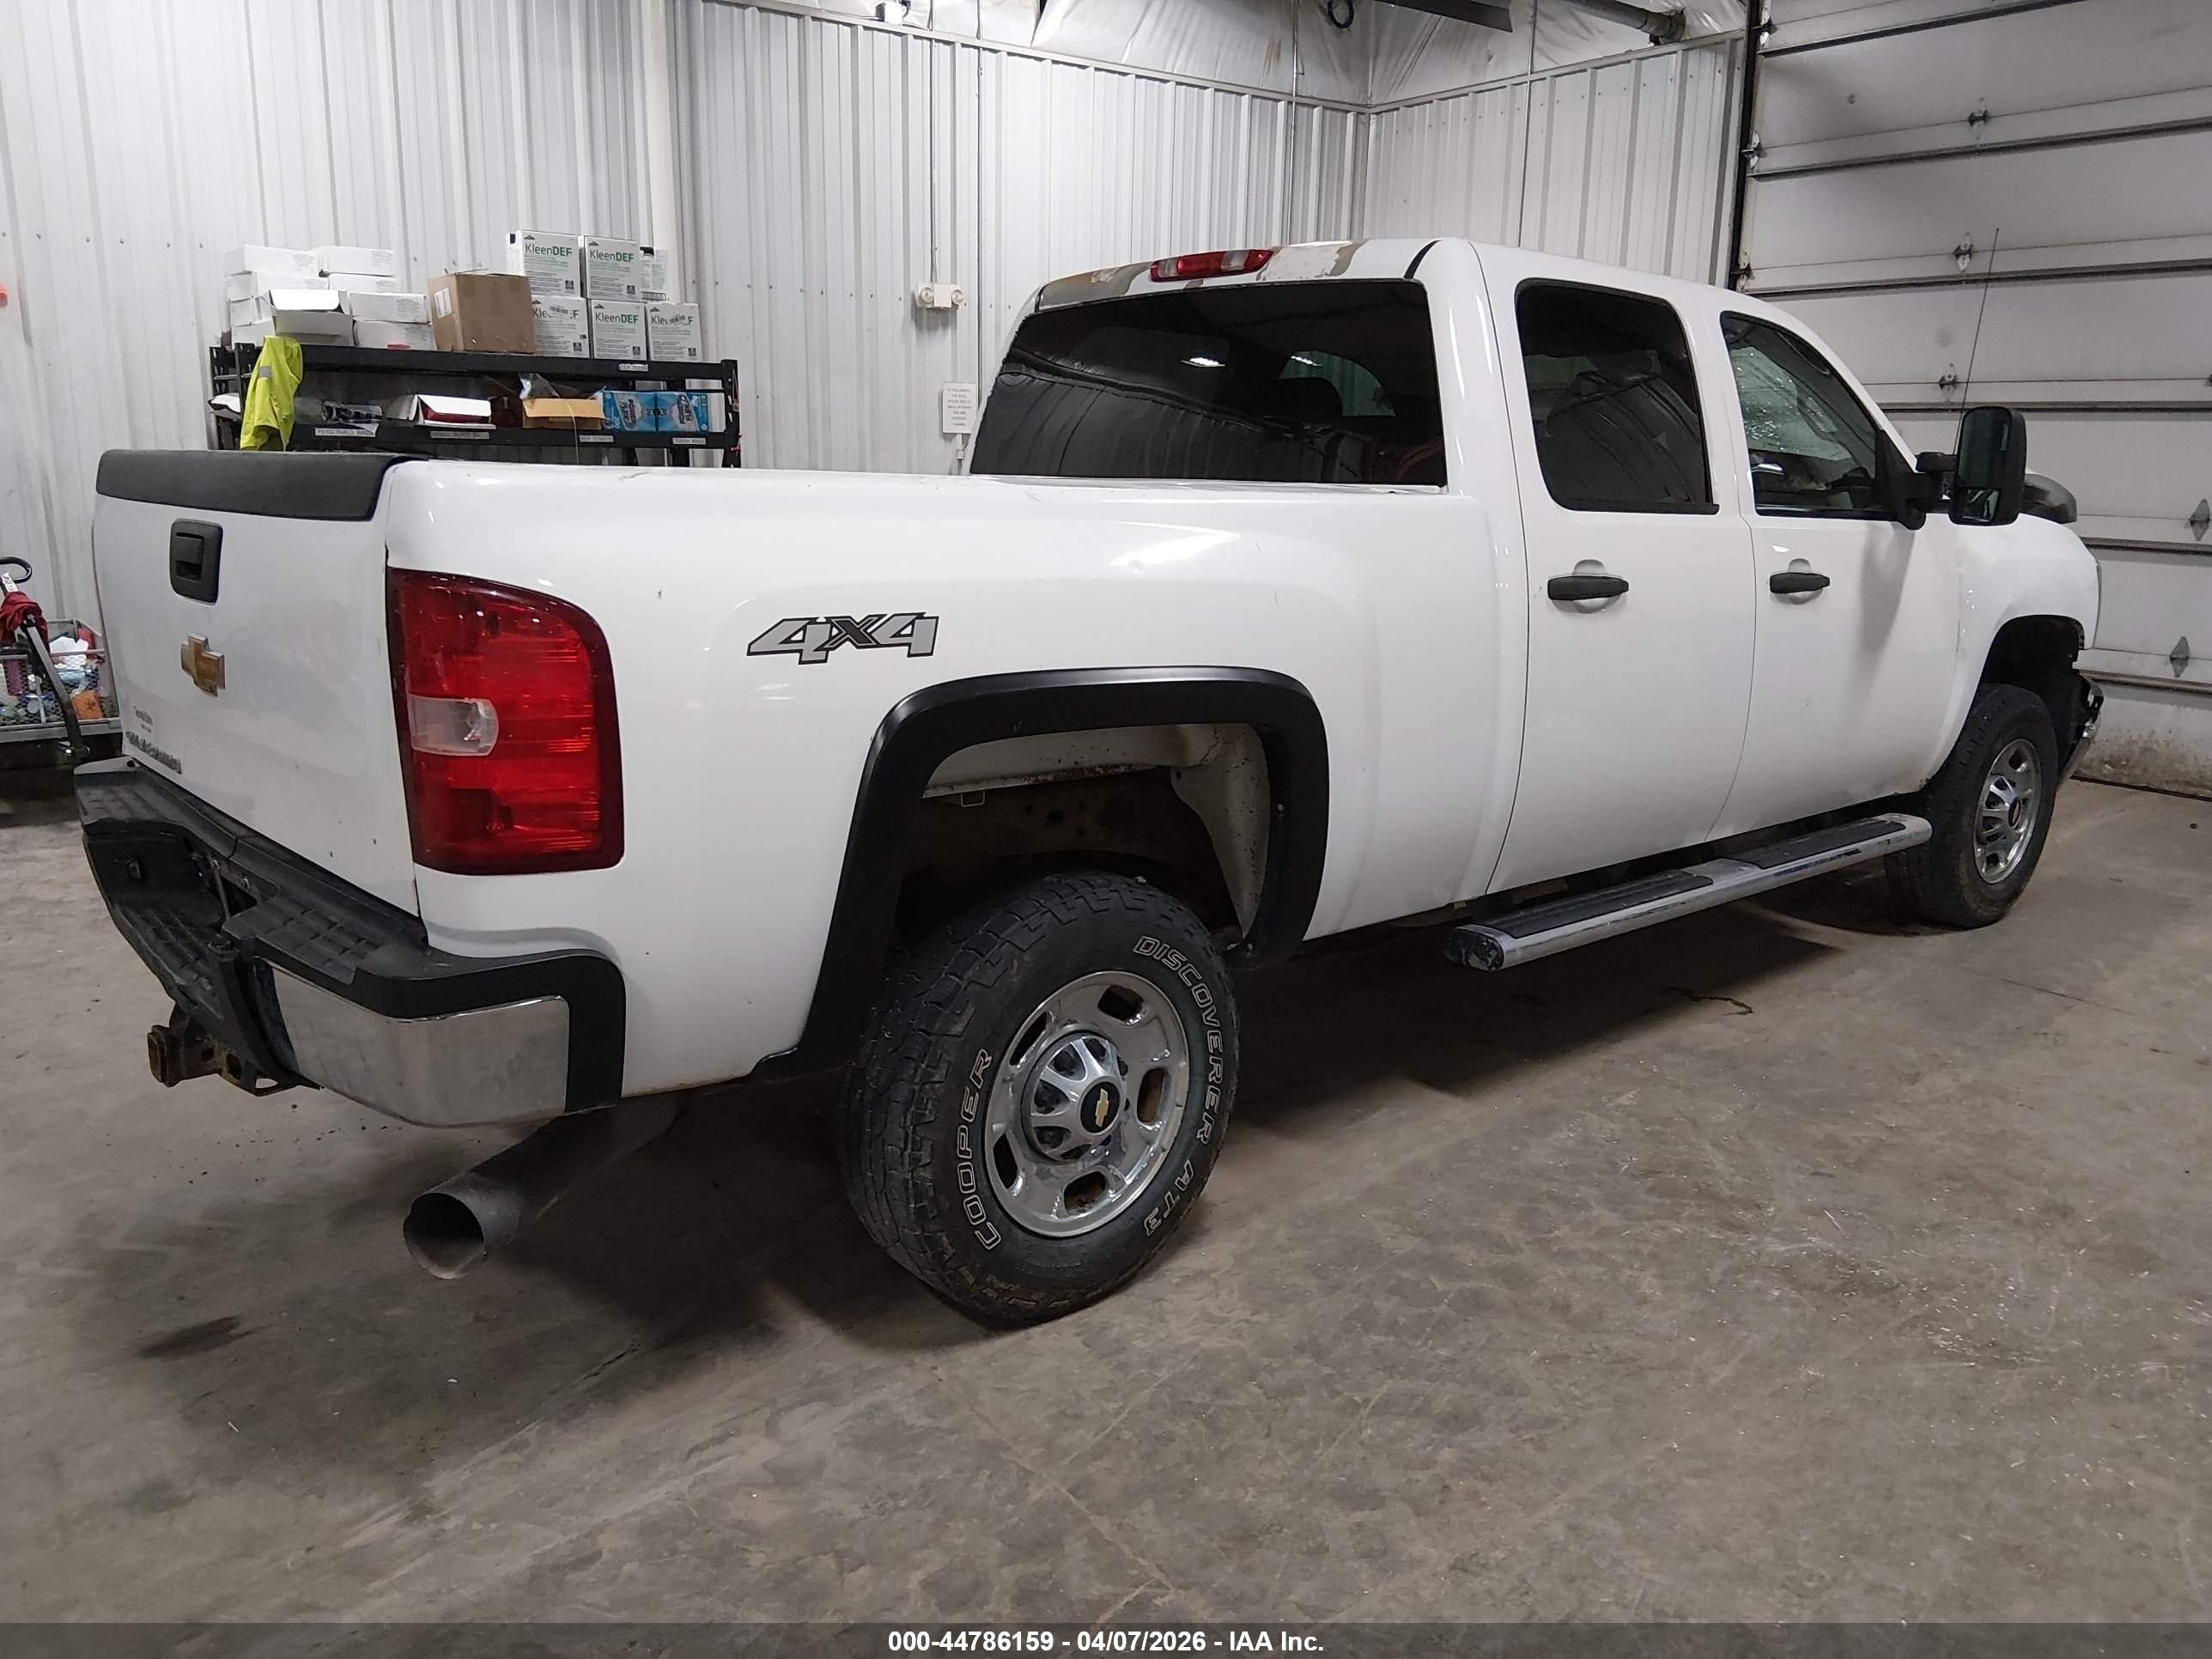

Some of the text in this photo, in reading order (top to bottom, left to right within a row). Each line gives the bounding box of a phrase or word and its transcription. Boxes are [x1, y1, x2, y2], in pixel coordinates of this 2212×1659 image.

[525, 244, 572, 257] KleenDEF
[589, 249, 634, 262] KleenDEF
[595, 313, 639, 324] KleenDEF
[1133, 935, 1223, 1237] DISCOVERER AT3
[957, 1048, 1001, 1250] COOPER
